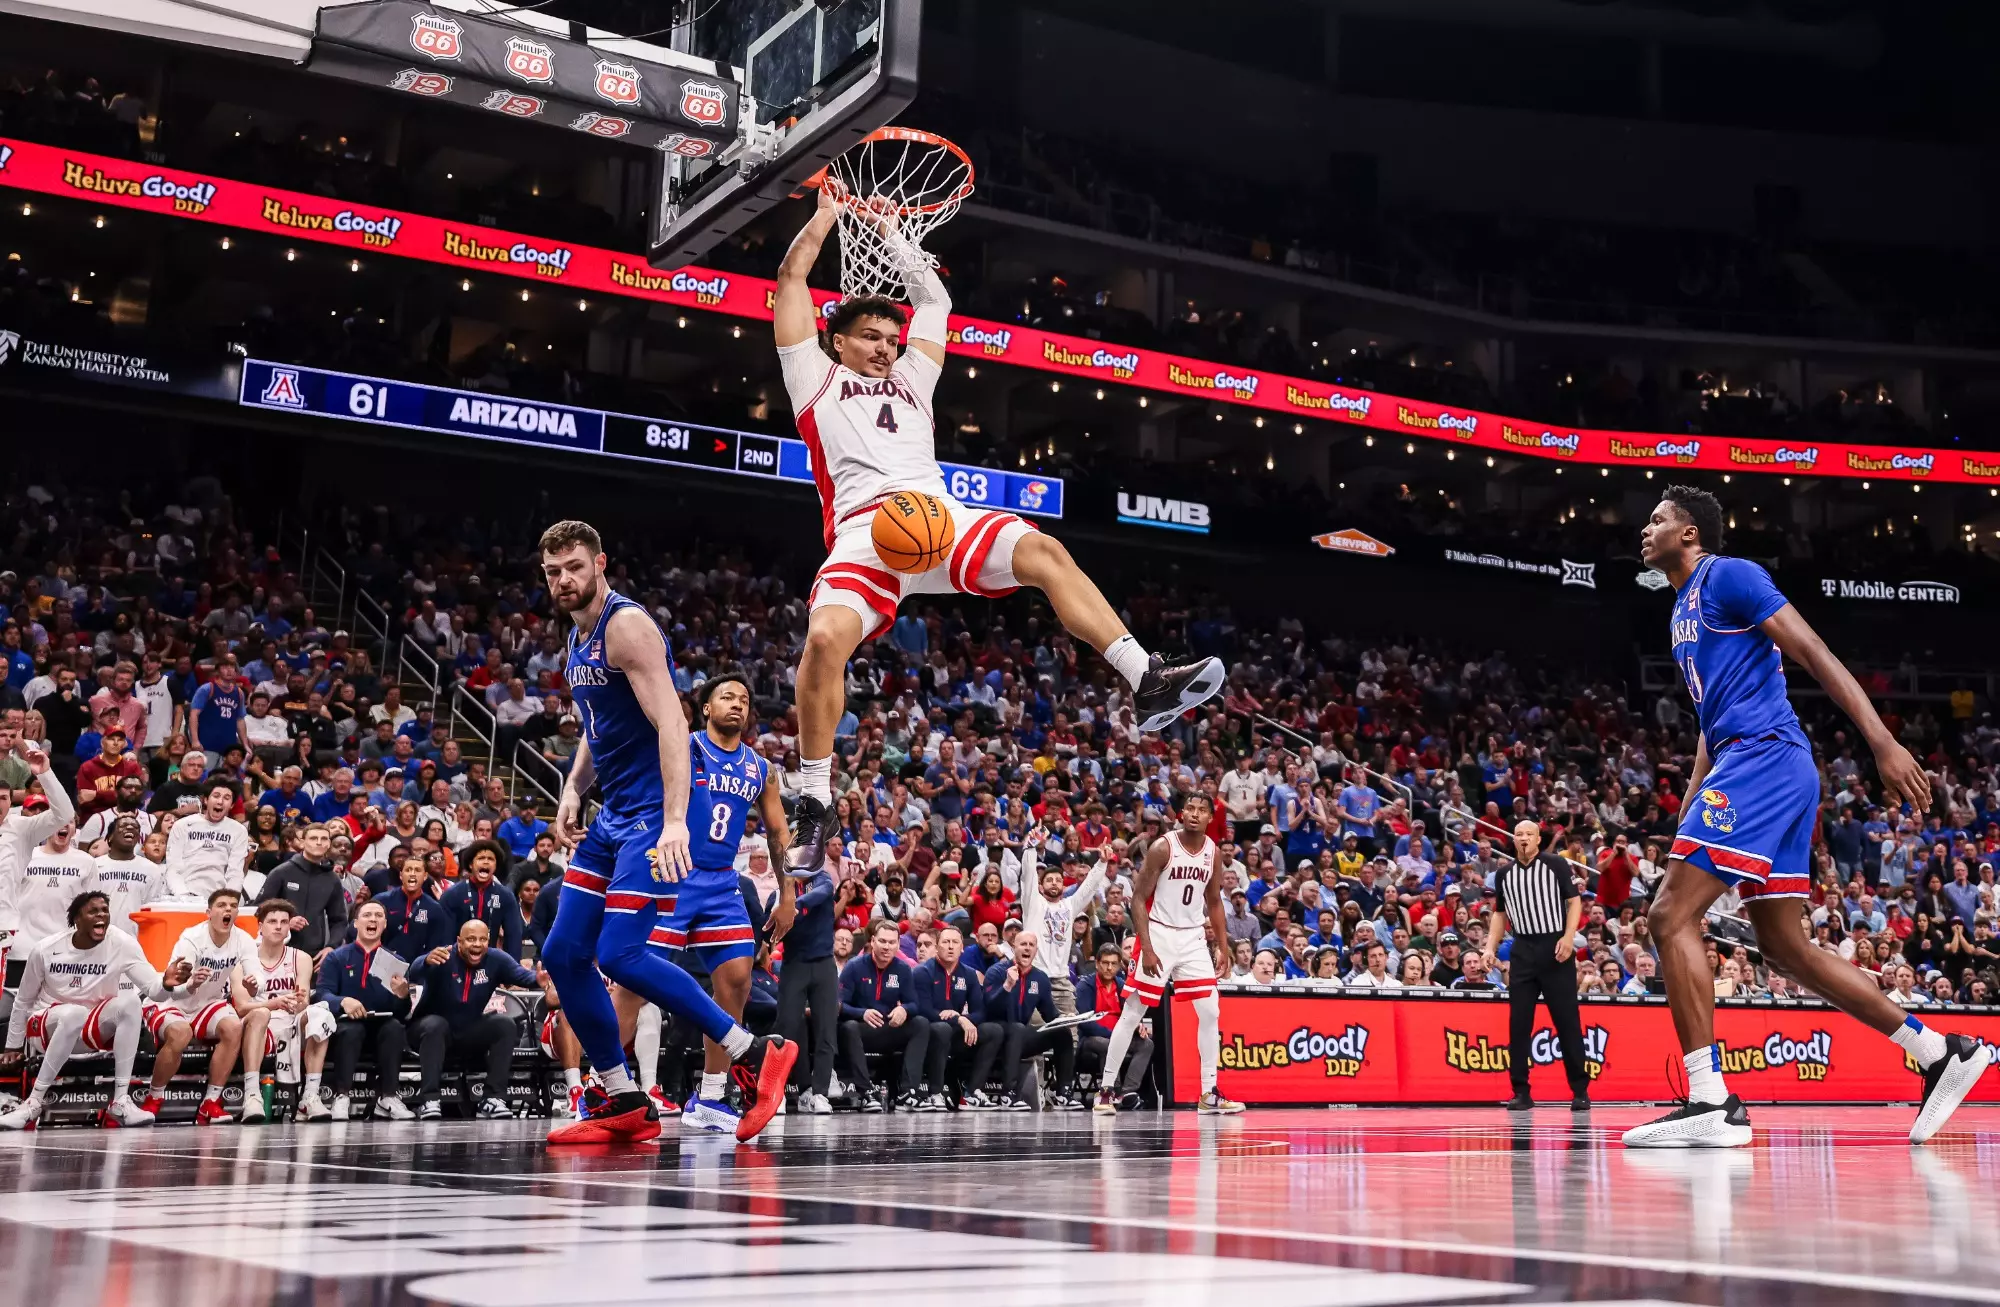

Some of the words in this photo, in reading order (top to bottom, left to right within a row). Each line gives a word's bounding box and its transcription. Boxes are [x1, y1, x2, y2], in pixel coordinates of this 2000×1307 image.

[419, 18, 456, 34] PHILLIPS
[420, 31, 453, 51] 66
[512, 41, 548, 57] PHILLIPS
[514, 54, 544, 74] 66
[601, 64, 635, 80] PHILLIPS
[603, 77, 632, 97] 66
[687, 85, 721, 100] PHILLIPS
[688, 98, 717, 117] 66
[63, 159, 141, 196] Heluva
[142, 176, 217, 206] Good!
[173, 199, 205, 214] DIP
[263, 197, 333, 231] Heluva
[333, 211, 402, 240] Good!
[363, 233, 391, 247] DIP
[444, 231, 509, 263] Heluva
[510, 244, 572, 269] Good!
[537, 264, 563, 278] DIP
[611, 262, 672, 291] Heluva
[672, 273, 729, 298] Good!
[697, 293, 720, 305] DIP
[961, 325, 1011, 348] Good!
[24, 340, 51, 354] THE
[54, 345, 129, 366] UNIVERSITY
[984, 345, 1005, 356] DIP
[1043, 340, 1092, 366] Heluva
[1092, 350, 1139, 371] Good!
[22, 352, 71, 369] KANSAS
[74, 360, 122, 376] HEALTH
[125, 366, 170, 382] SYSTEM
[1113, 367, 1133, 379] DIP
[1169, 363, 1214, 389] Heluva
[1214, 372, 1258, 394] Good!
[1235, 389, 1253, 400] DIP
[1287, 385, 1330, 409] Heluva
[1330, 393, 1371, 414] Good!
[876, 403, 899, 433] 4
[1349, 410, 1365, 420] DIP
[1398, 405, 1438, 429] Heluva
[1438, 413, 1477, 433] Good!
[349, 382, 387, 418] 61
[449, 397, 578, 438] ARIZONA
[645, 424, 690, 451] 8:31
[743, 449, 774, 466] 2ND
[950, 470, 988, 501] 63
[1502, 424, 1541, 447] Heluva
[1541, 432, 1580, 450] Good!
[1610, 438, 1656, 457] Heluva
[1656, 441, 1700, 457] Good!
[1729, 445, 1775, 464] Heluva
[1775, 448, 1819, 463] Good!
[1847, 452, 1892, 470] Heluva
[1891, 454, 1935, 469] Good!
[1963, 459, 2000, 477] Heluv
[1117, 491, 1211, 526] UMB
[1328, 535, 1377, 551] SERVPRO
[1453, 551, 1477, 563] Mobile
[1478, 556, 1502, 566] CENTER
[1507, 559, 1514, 568] is
[1515, 561, 1538, 572] Home
[1539, 564, 1547, 573] of
[1548, 565, 1560, 575] the
[1839, 579, 1895, 599] Mobile
[1898, 587, 1955, 602] CENTER
[708, 773, 758, 802] ANSAS
[709, 803, 732, 841] 8
[26, 867, 61, 877] NOTHING
[99, 871, 130, 882] NOTHING
[1182, 884, 1194, 906] 0
[49, 962, 88, 975] NOTHING
[265, 977, 296, 992] ZONA
[1287, 1023, 1370, 1064] Good!
[1444, 1026, 1534, 1073] Heluv
[1531, 1023, 1610, 1066] God!
[1717, 1038, 1768, 1074] luva
[1764, 1028, 1833, 1066] Good!
[1325, 1058, 1361, 1077] DIP
[1797, 1063, 1828, 1081] DIP
[57, 1092, 108, 1103] Allstate
[162, 1090, 202, 1101] llstate
[348, 1089, 376, 1098] state
